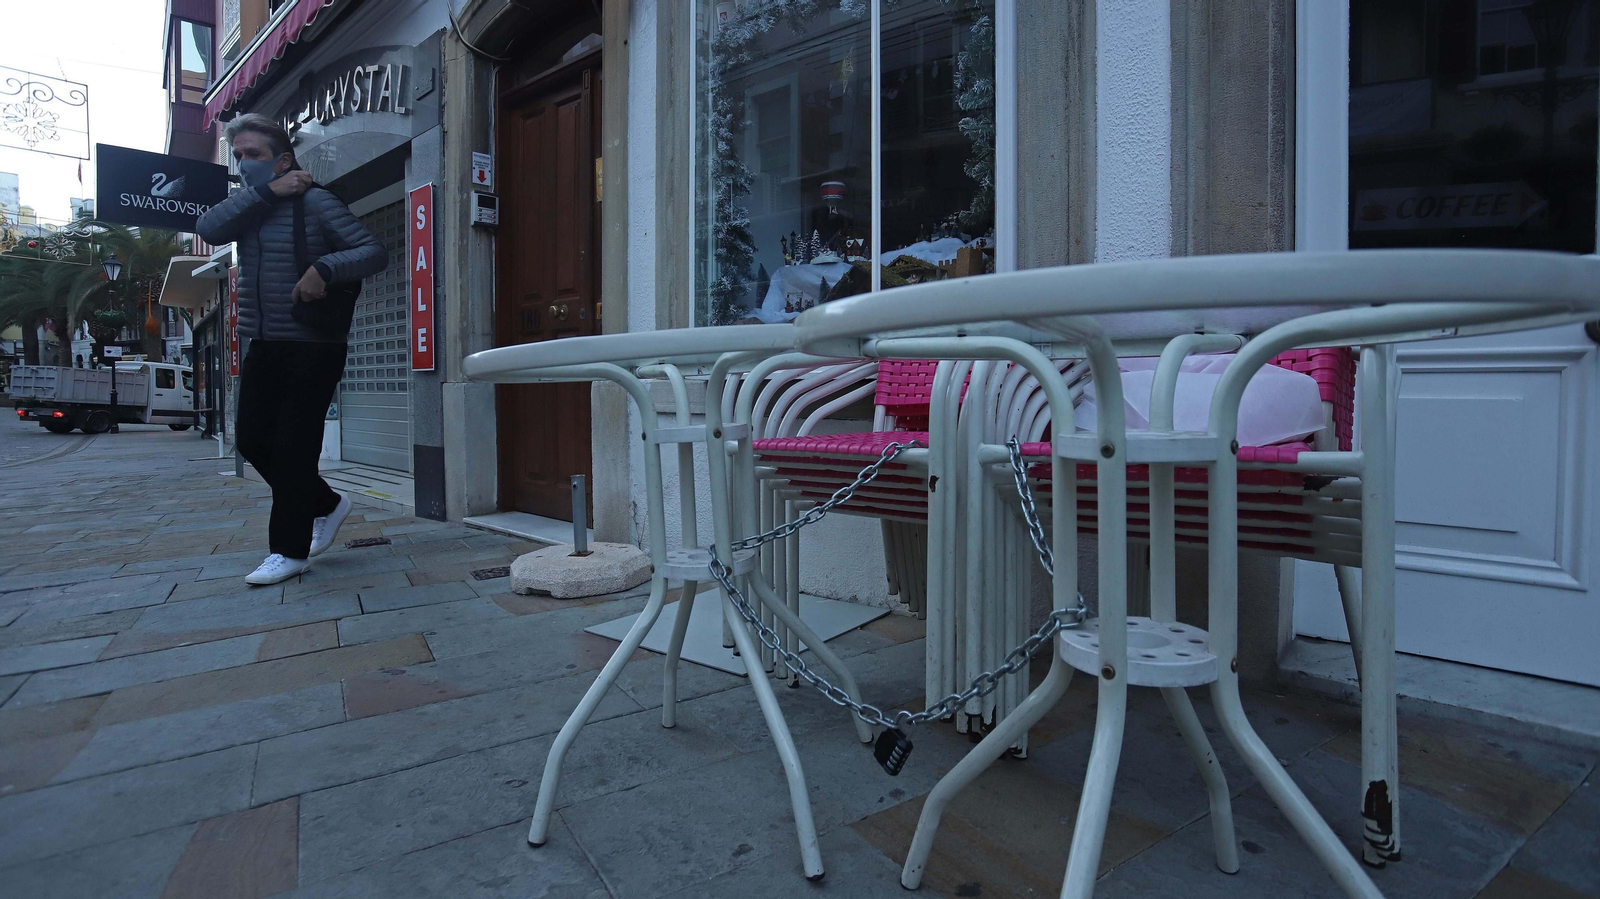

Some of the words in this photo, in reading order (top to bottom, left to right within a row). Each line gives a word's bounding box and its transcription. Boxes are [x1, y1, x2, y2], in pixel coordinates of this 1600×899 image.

[314, 63, 406, 123] CRYSTAL
[1396, 192, 1515, 219] COFFEE
[415, 204, 427, 353] SALE
